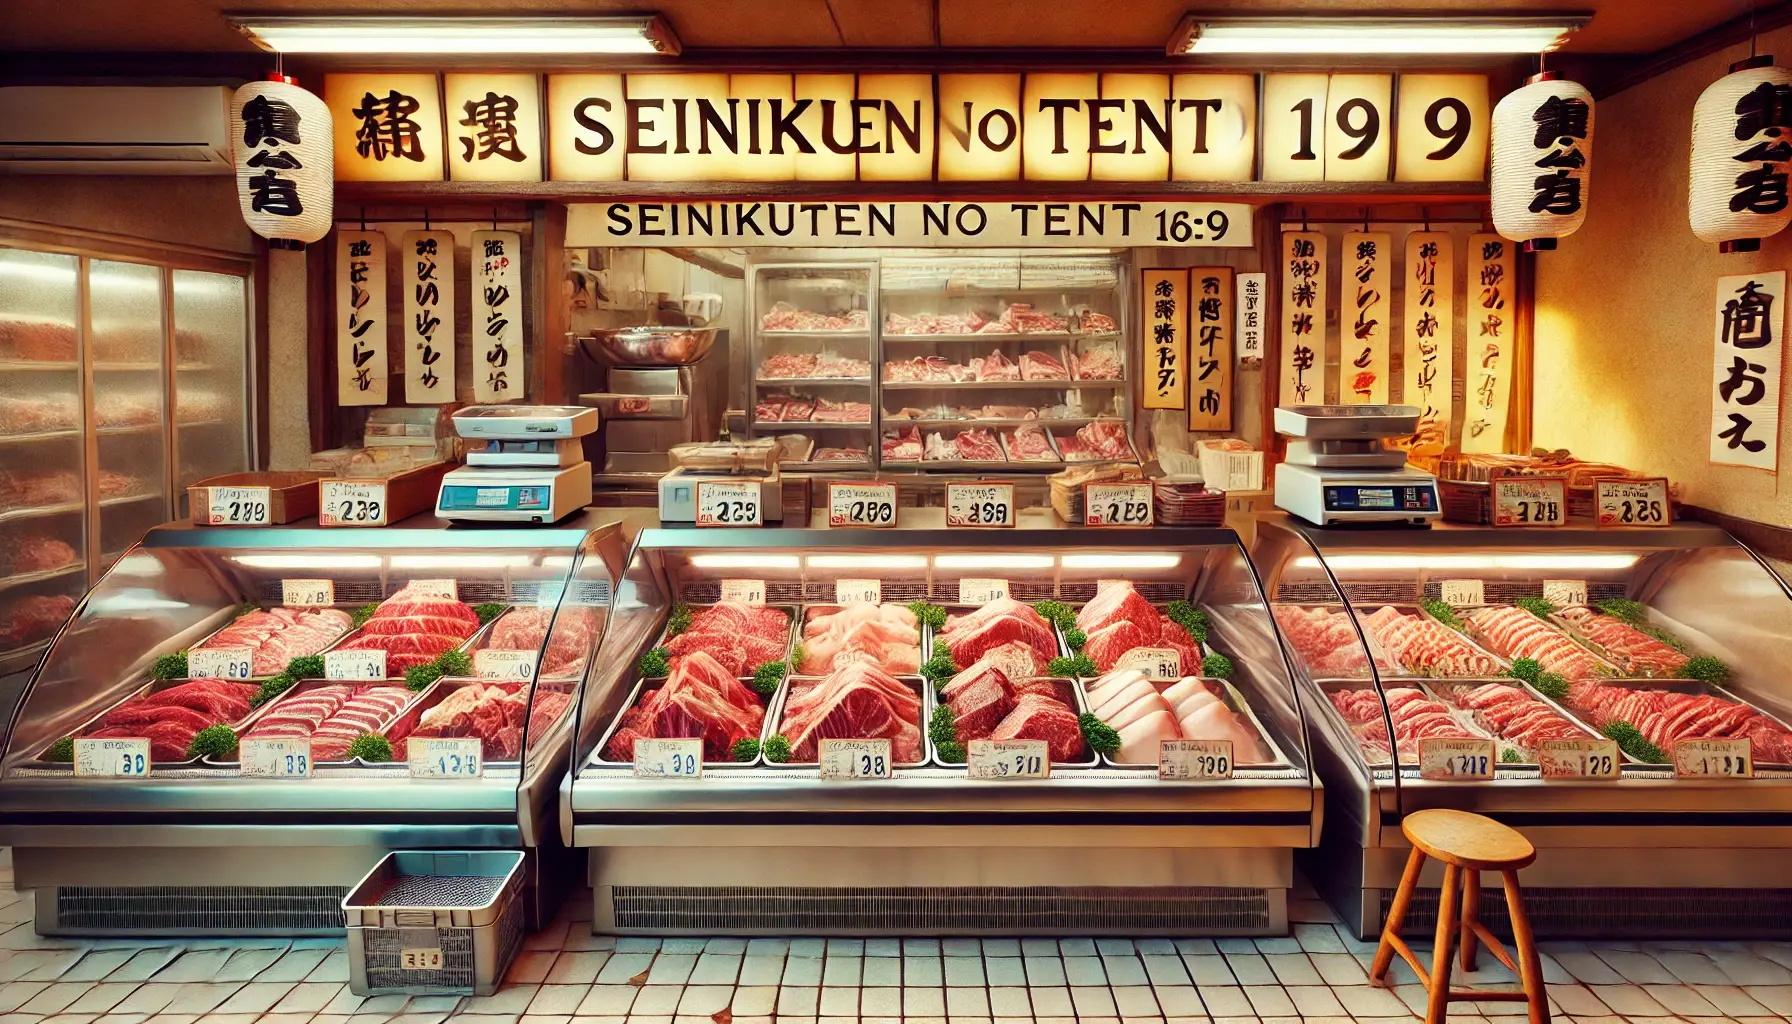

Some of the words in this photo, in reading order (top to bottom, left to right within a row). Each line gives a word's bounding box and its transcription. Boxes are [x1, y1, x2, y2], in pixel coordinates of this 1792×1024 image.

[573, 97, 921, 155] SEINIKUEN
[1038, 98, 1222, 154] TENT
[607, 203, 896, 236] SEINIKUTEN
[922, 203, 987, 236] NO
[1011, 203, 1141, 236] TENT
[1154, 209, 1229, 241] 16:9
